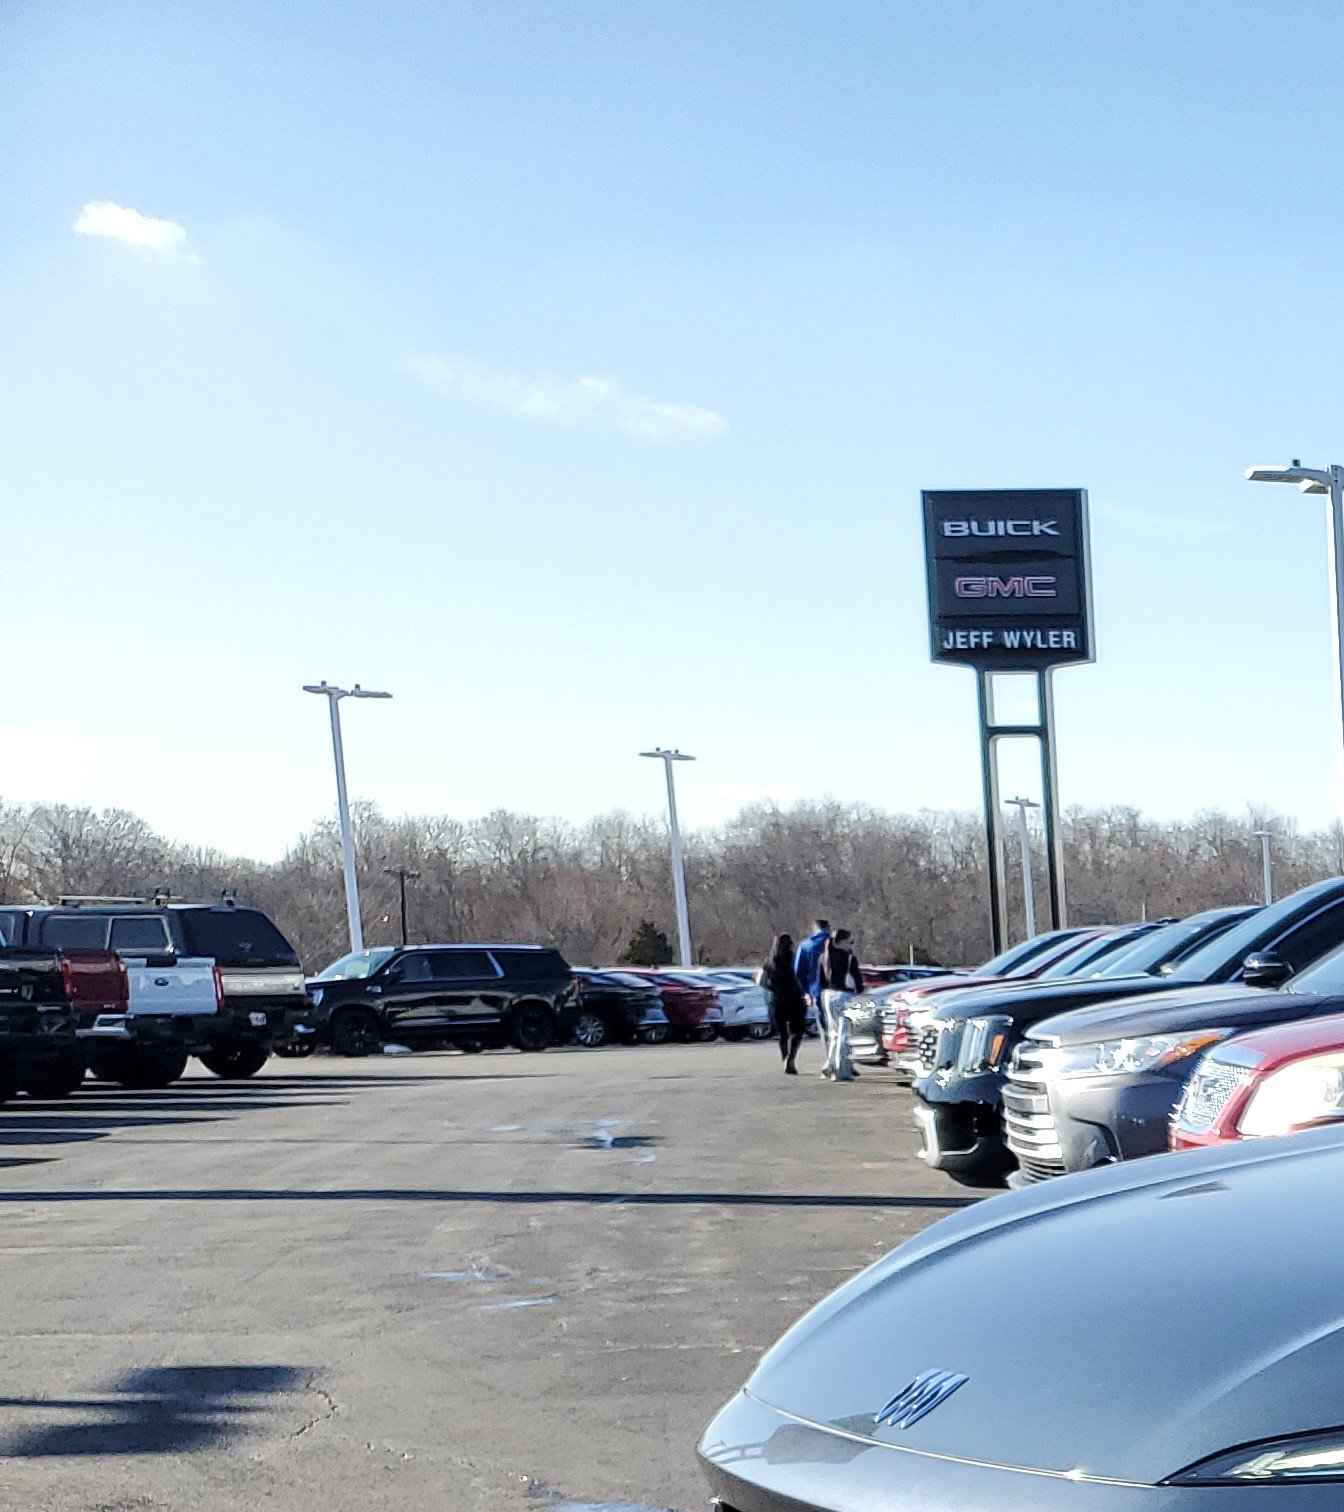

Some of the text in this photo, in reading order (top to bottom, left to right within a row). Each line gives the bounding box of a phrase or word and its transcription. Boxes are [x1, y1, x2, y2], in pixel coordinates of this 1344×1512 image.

[943, 520, 1061, 537] BUICK
[955, 576, 1057, 598] GMC
[942, 631, 1077, 649] JEFF WYLER
